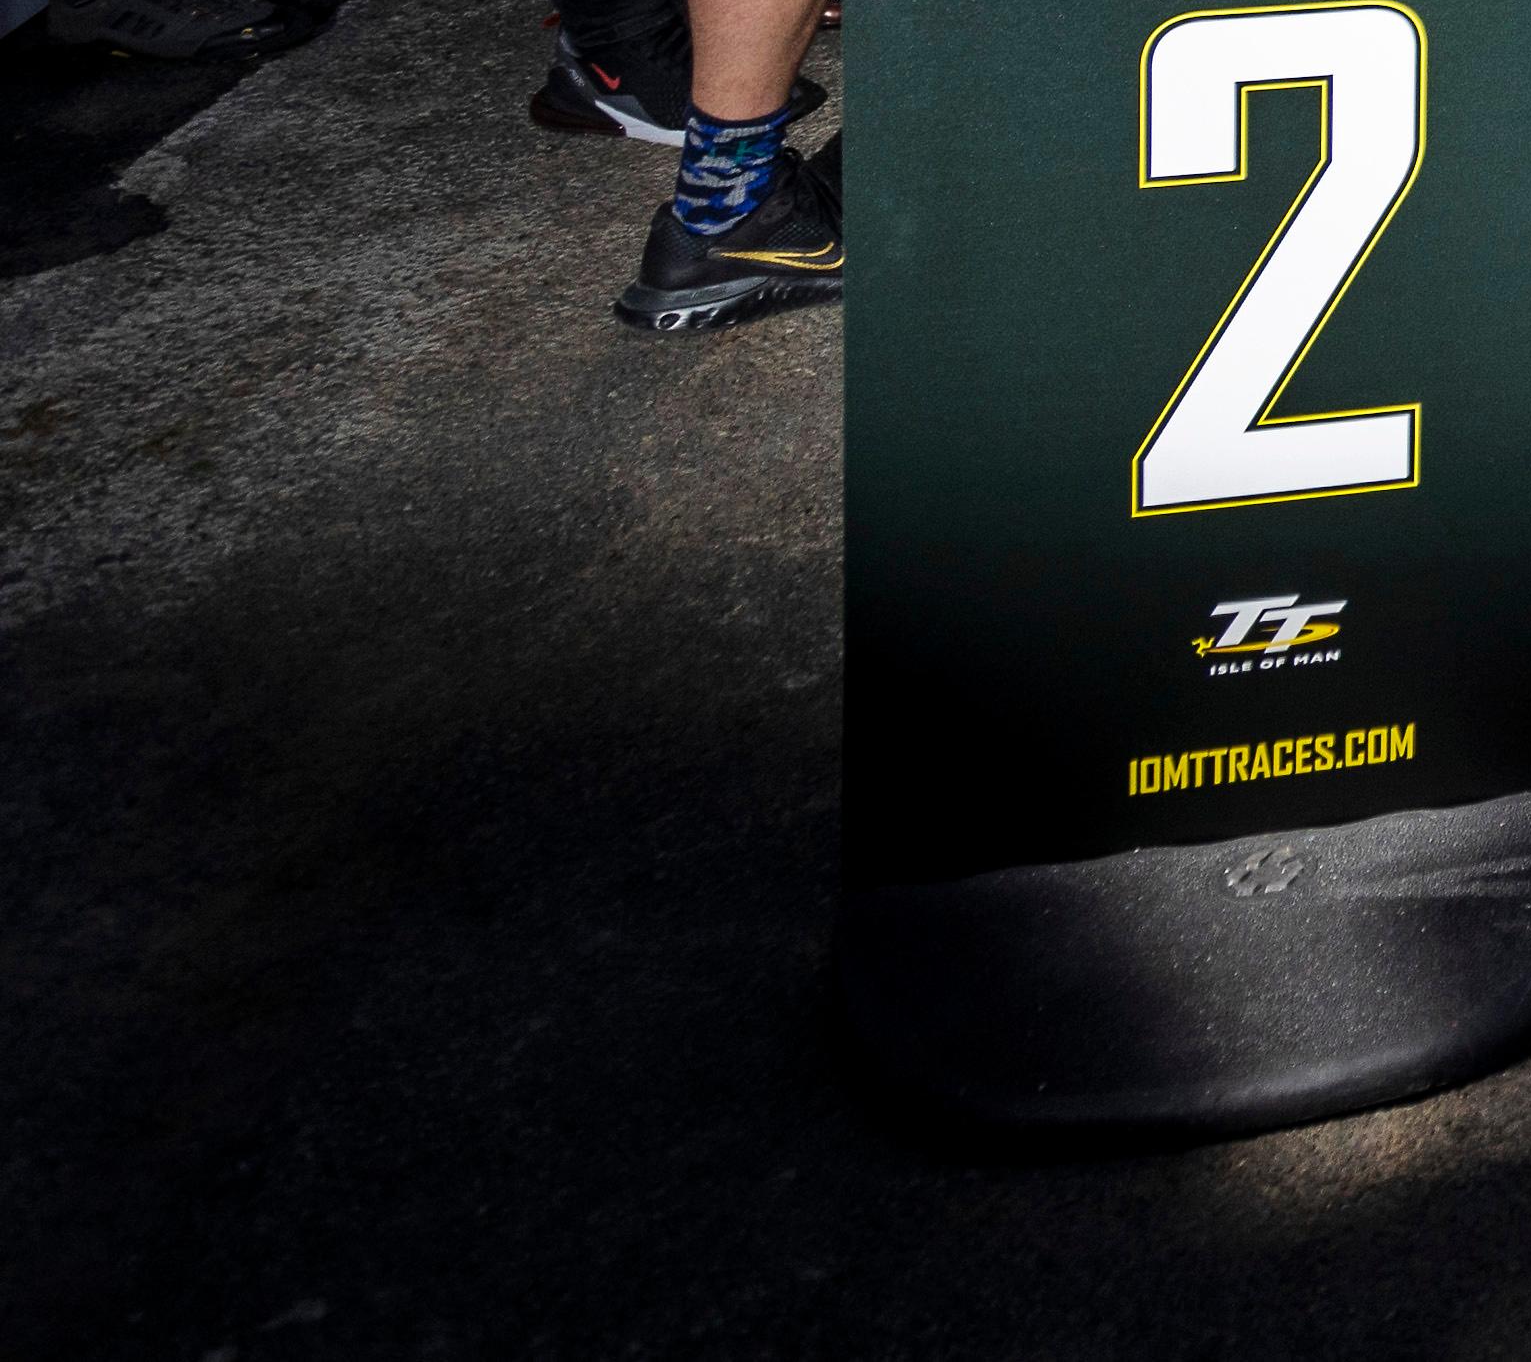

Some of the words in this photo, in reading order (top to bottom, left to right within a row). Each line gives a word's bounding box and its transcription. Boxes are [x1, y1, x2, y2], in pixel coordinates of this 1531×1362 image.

[1209, 593, 1348, 653] TT
[1210, 660, 1253, 676] ISLE
[1259, 656, 1286, 671] OF
[1293, 649, 1341, 666] MAN
[1128, 723, 1417, 797] IOMTTRACES.COM
